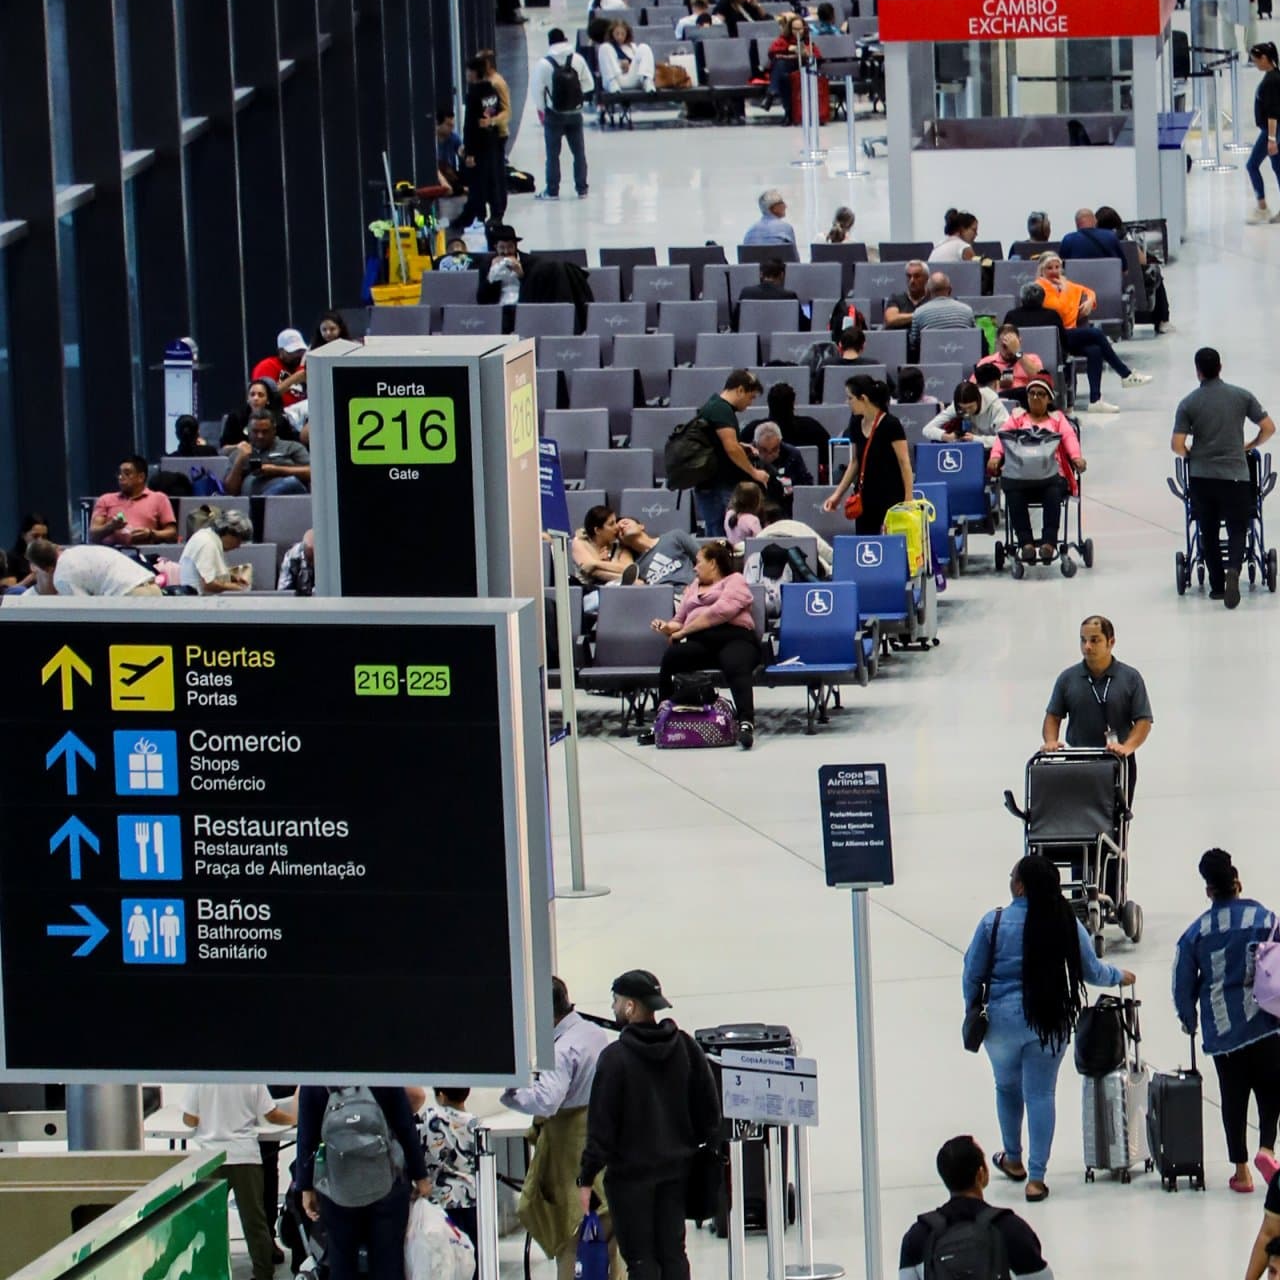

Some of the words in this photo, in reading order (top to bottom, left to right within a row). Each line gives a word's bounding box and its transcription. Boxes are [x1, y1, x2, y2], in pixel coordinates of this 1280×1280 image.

[983, 0, 1058, 16] CAMBIO
[968, 16, 1068, 34] EXCHANGE
[376, 381, 426, 396] Puerta
[511, 398, 533, 445] 216
[356, 409, 449, 452] 216
[388, 467, 420, 480] Gate
[186, 645, 276, 668] Puertas
[186, 670, 233, 687] Gates
[357, 670, 396, 691] 216
[409, 671, 448, 691] 225
[187, 690, 238, 706] Portas
[189, 729, 302, 753] Comercio
[190, 755, 240, 774] Shops
[190, 775, 266, 792] Comércio
[827, 778, 864, 787] Airlines
[837, 771, 864, 780] Copa
[194, 814, 349, 839] Restaurantes
[194, 840, 289, 857] Restaurants
[195, 861, 240, 880] Praça
[244, 860, 265, 876] de
[269, 859, 366, 880] Alimentação
[197, 897, 271, 921] Baños
[197, 923, 282, 940] Bathrooms
[198, 942, 268, 960] Sanitário
[735, 1075, 742, 1087] 3
